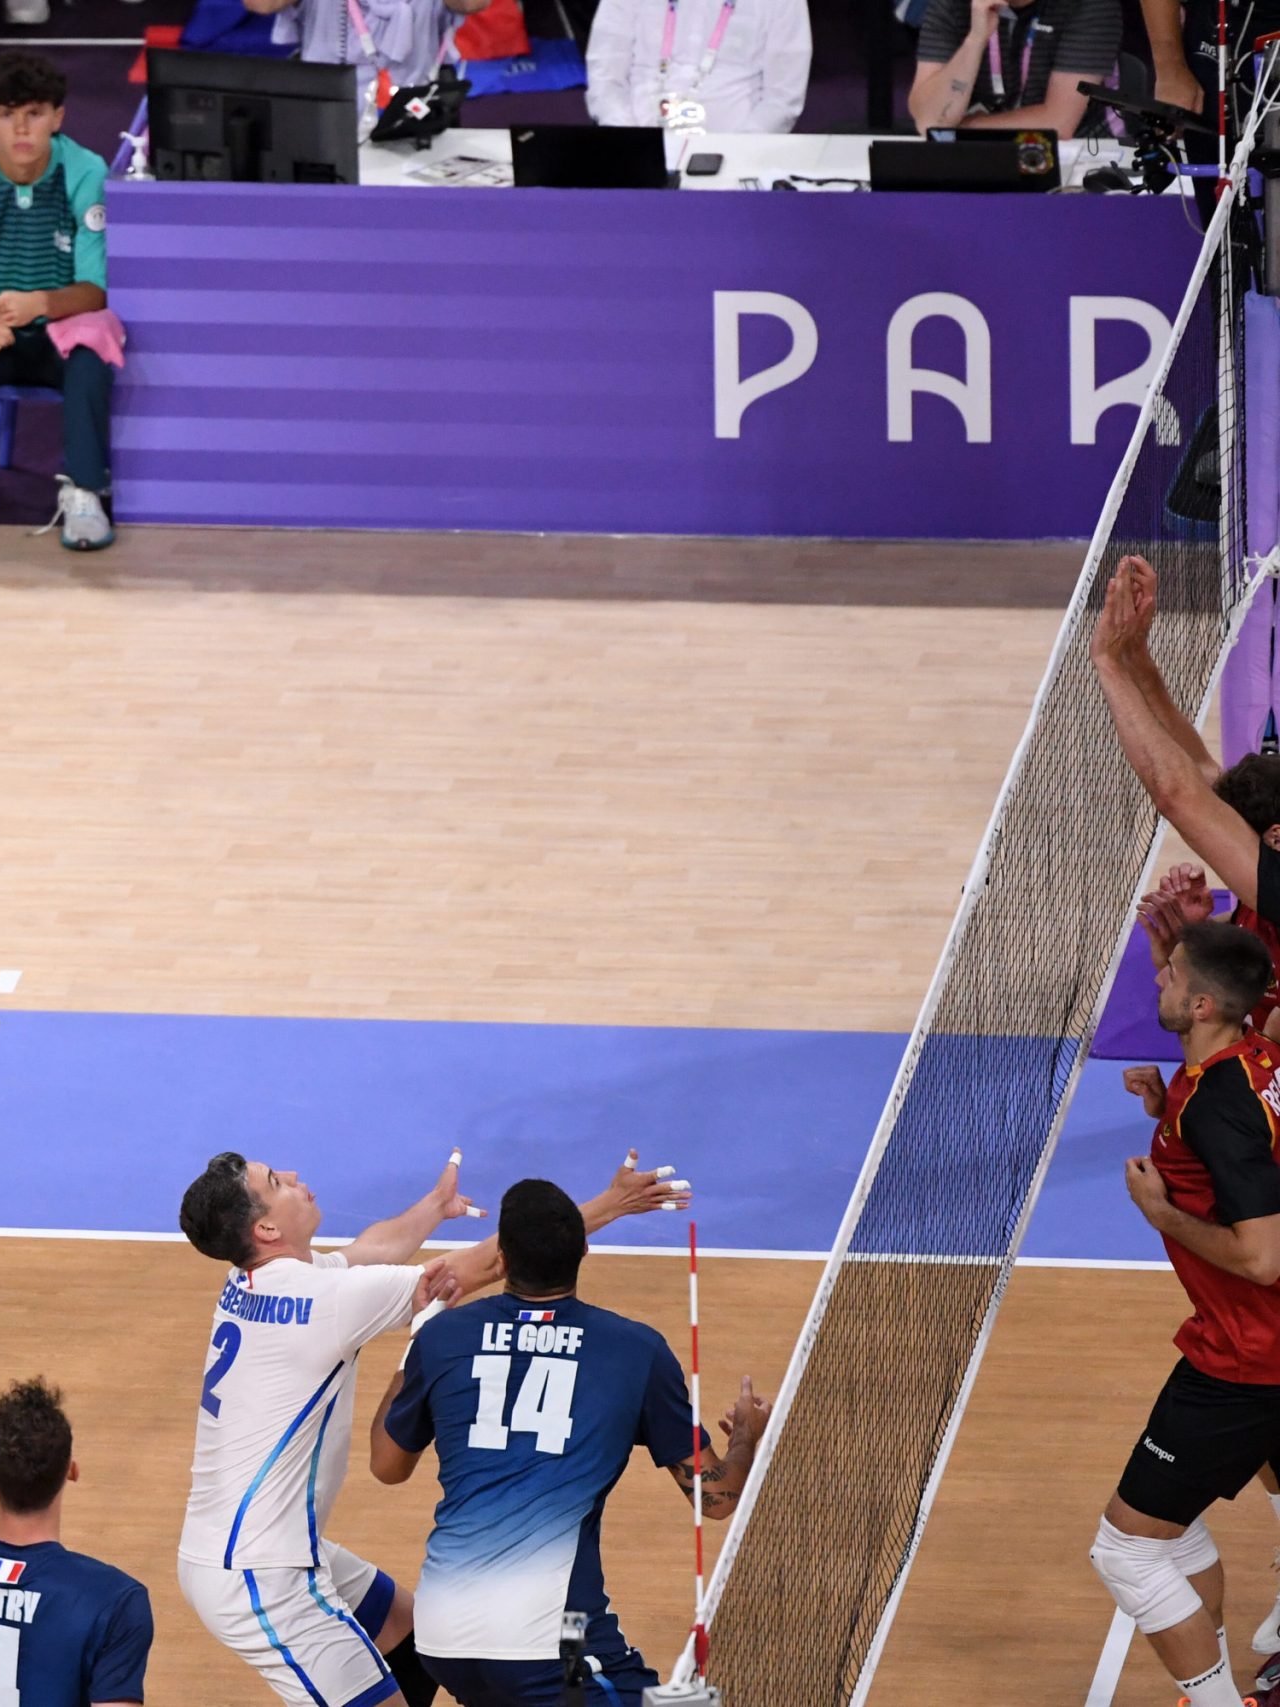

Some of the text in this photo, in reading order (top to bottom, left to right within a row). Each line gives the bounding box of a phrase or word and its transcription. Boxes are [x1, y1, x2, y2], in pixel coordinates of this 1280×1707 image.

[201, 1321, 242, 1419] 2
[481, 1322, 584, 1355] LE GOFF
[468, 1354, 579, 1455] 14
[1143, 1436, 1176, 1463] Kempa
